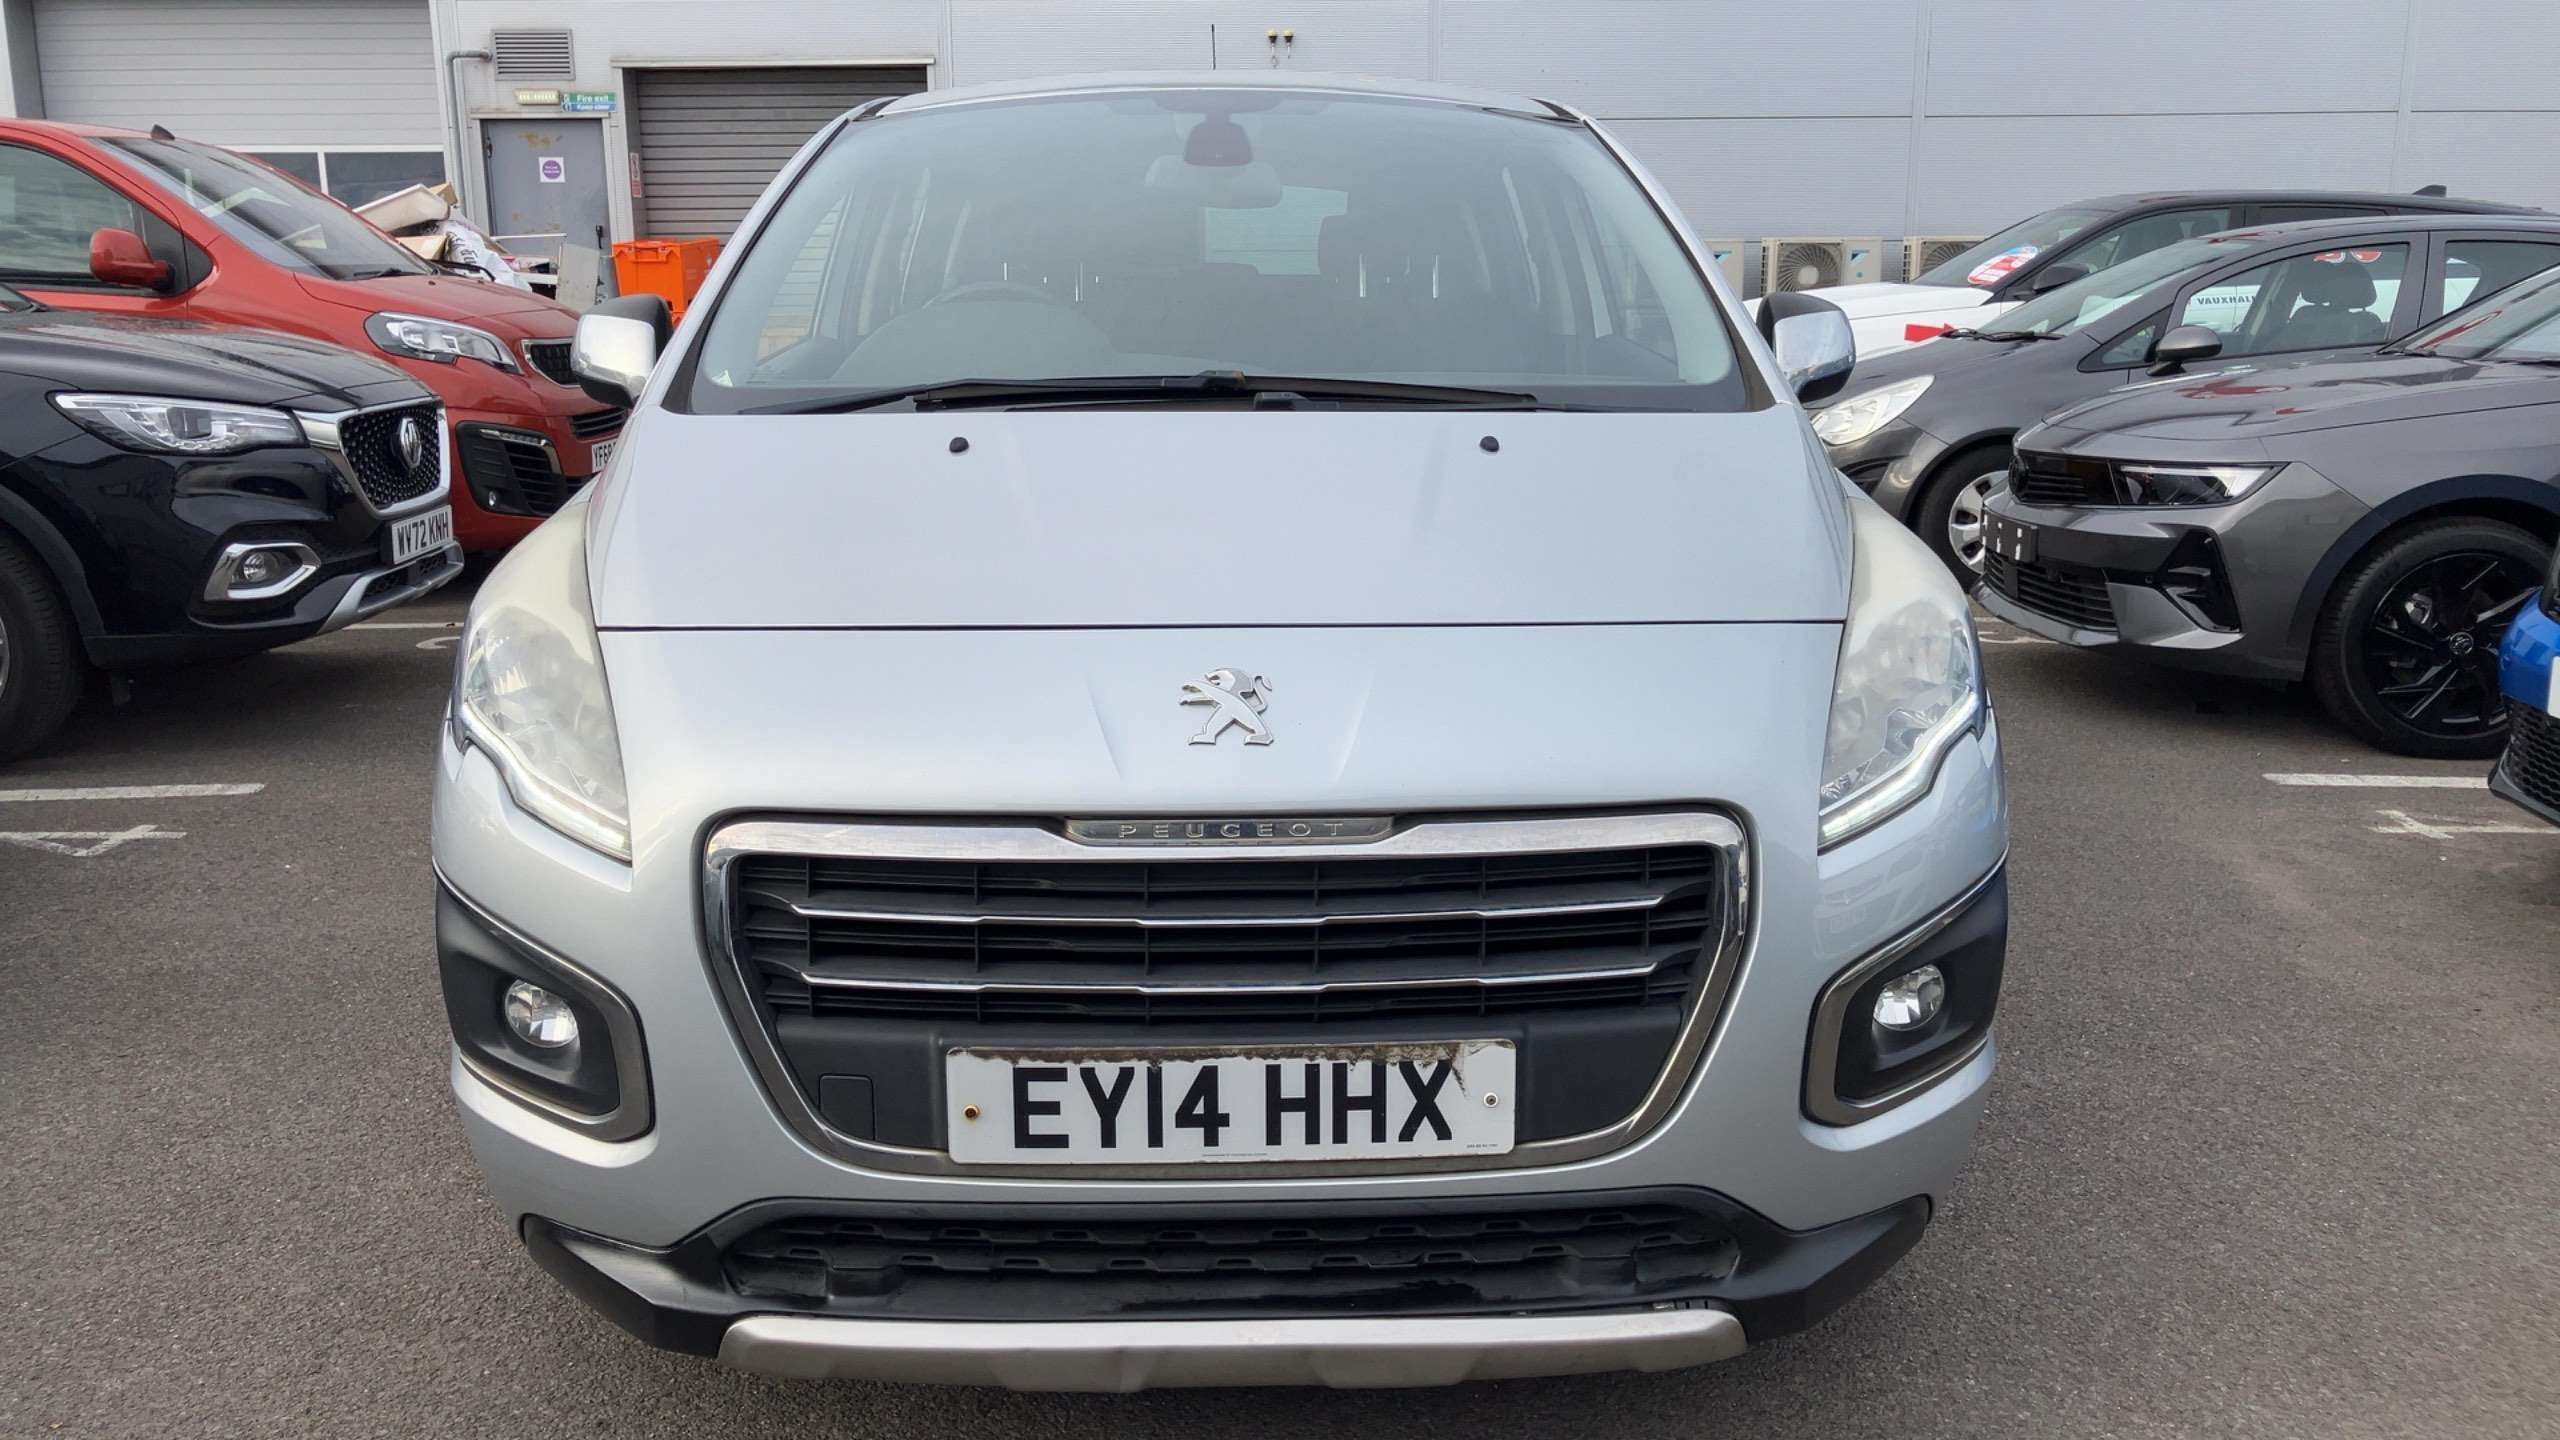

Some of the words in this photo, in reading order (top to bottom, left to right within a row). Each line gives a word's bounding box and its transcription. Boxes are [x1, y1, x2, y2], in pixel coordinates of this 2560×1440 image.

[1118, 823, 1344, 838] PEUGEOT
[1012, 1064, 1230, 1149] EY14
[1264, 1060, 1453, 1146] HHX
